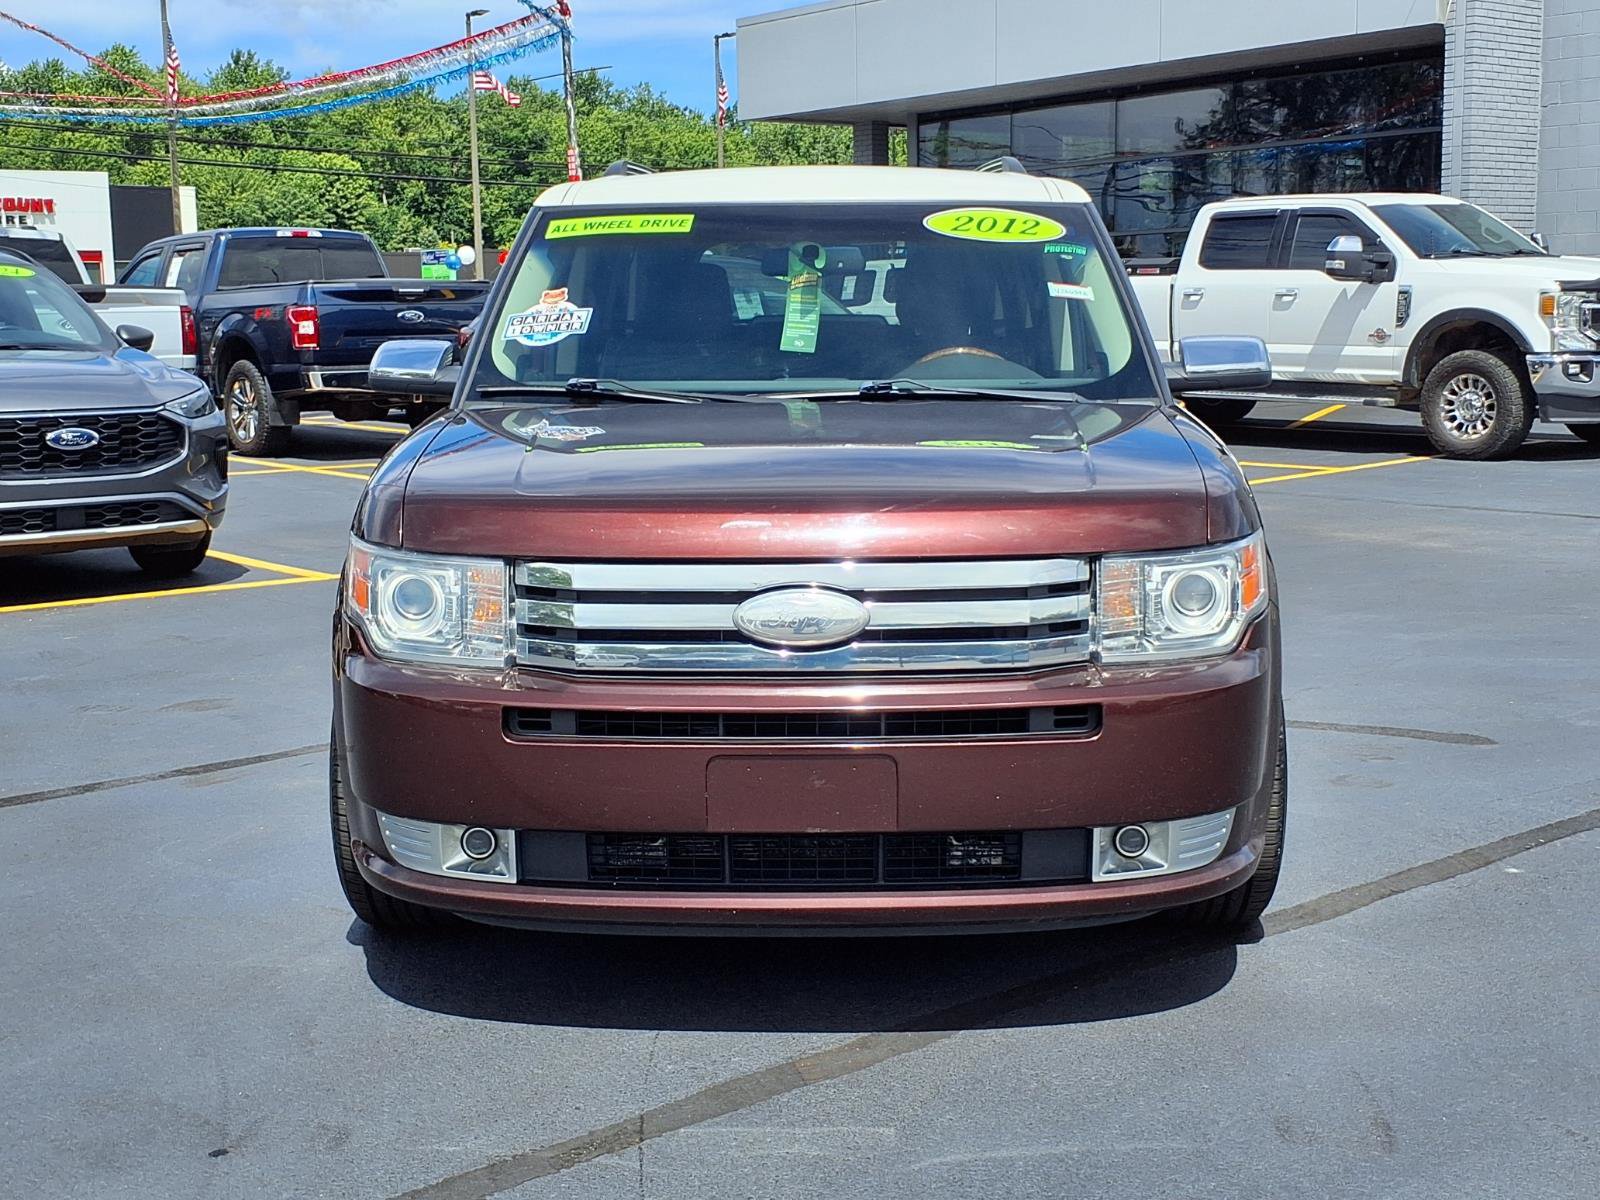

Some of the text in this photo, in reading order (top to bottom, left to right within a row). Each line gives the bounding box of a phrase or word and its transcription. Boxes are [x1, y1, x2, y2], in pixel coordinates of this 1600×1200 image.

[0, 197, 54, 213] OUNT
[551, 218, 689, 234] ALL WHEEL DRIVE
[951, 215, 1041, 236] 2012
[1044, 244, 1087, 256] PROTECTION
[520, 321, 584, 335] OWNER
[59, 432, 87, 445] Ford
